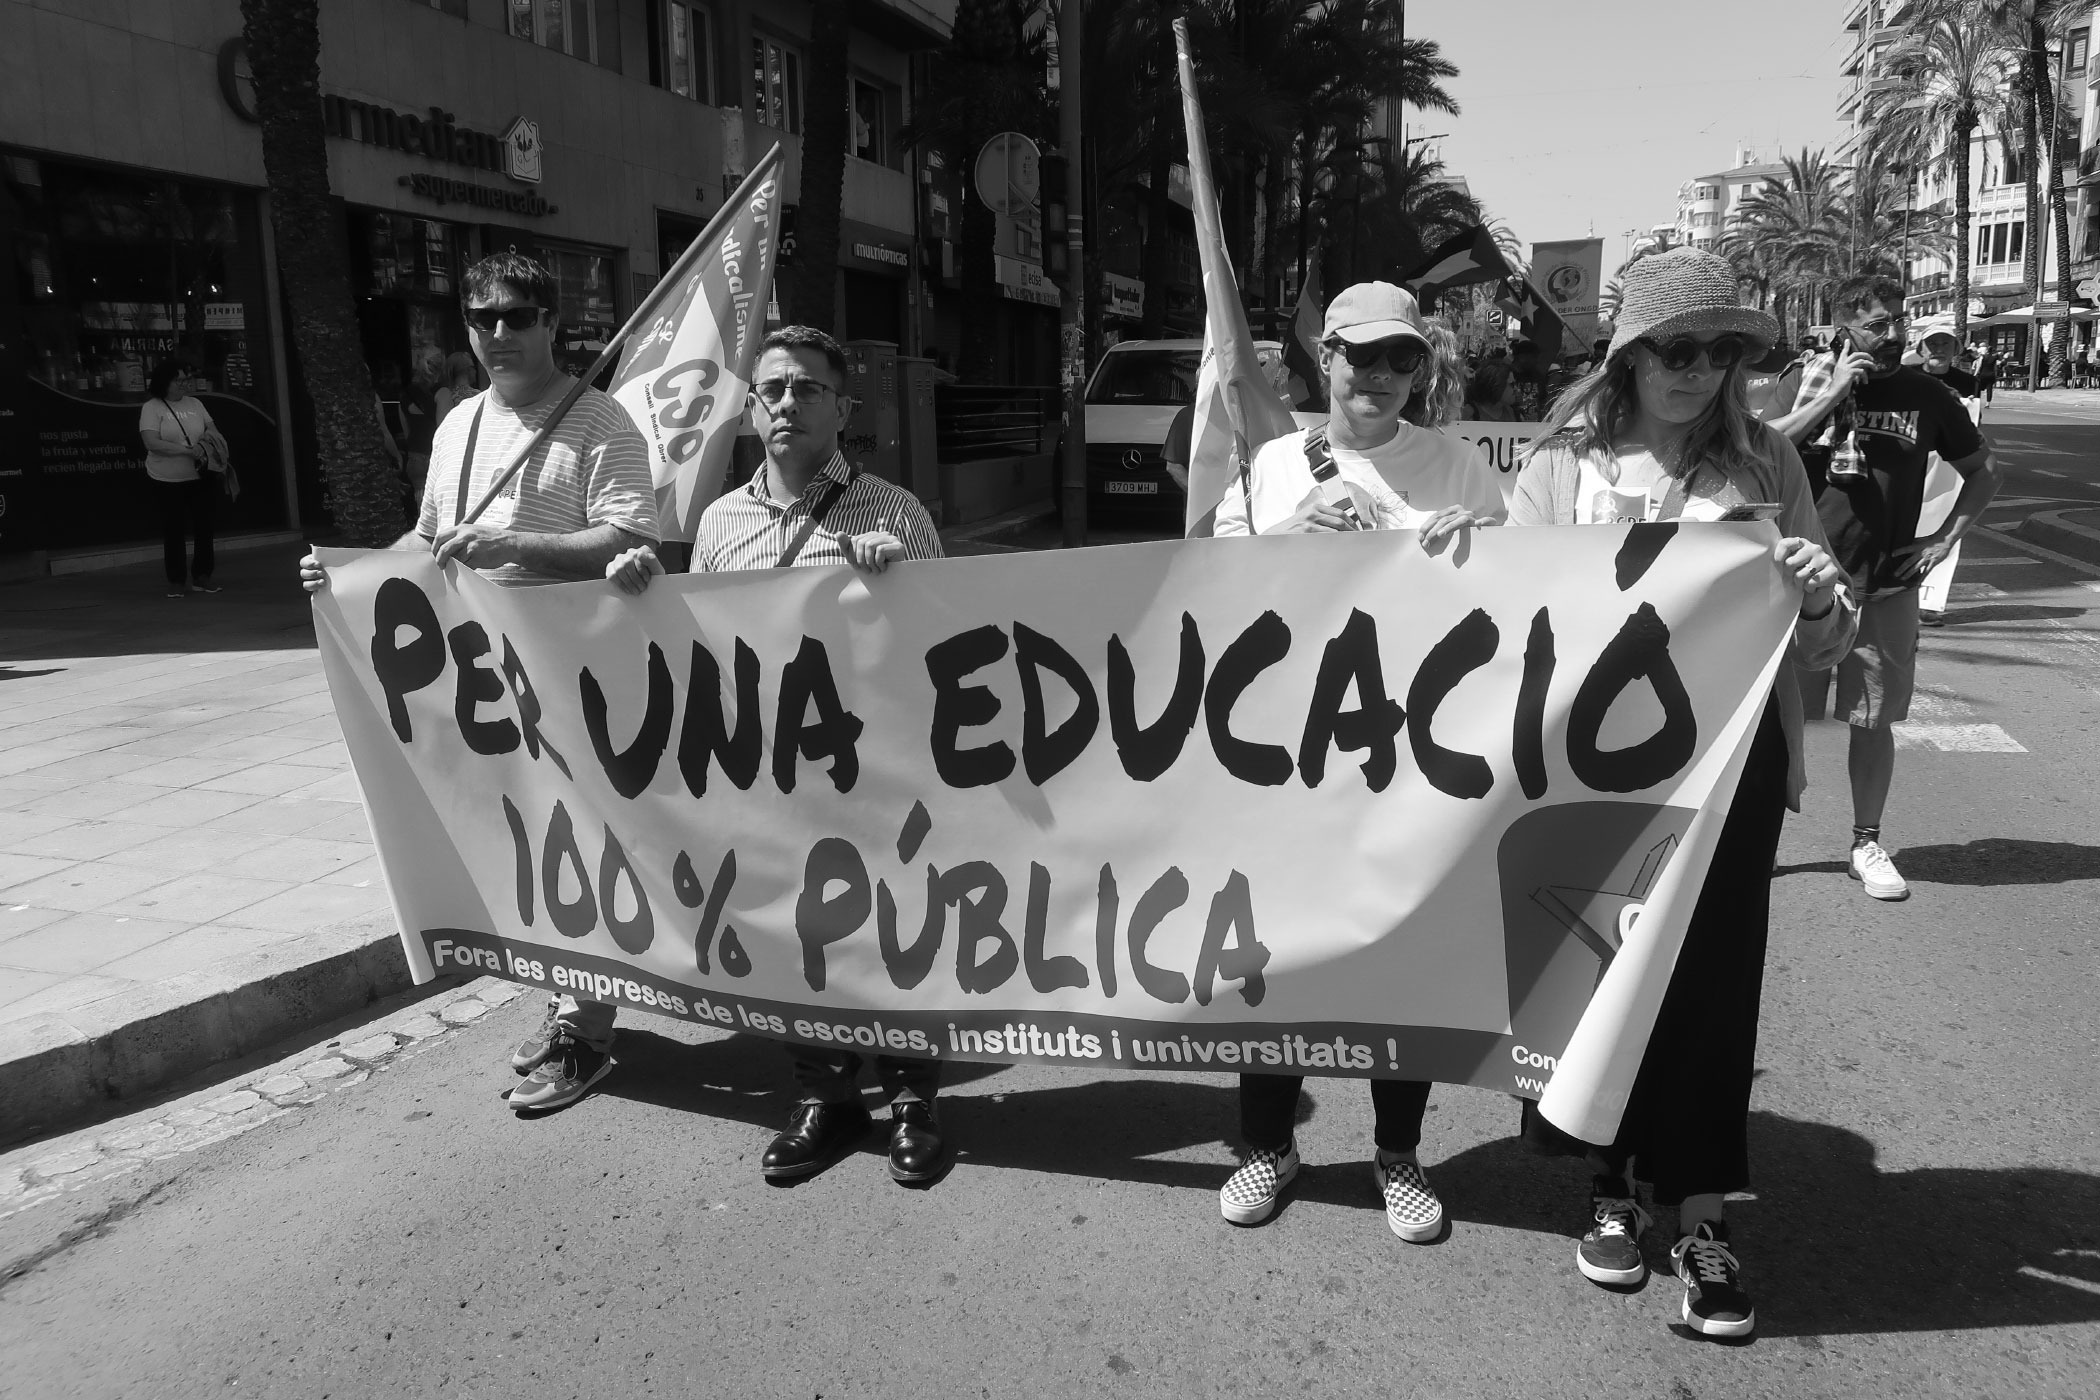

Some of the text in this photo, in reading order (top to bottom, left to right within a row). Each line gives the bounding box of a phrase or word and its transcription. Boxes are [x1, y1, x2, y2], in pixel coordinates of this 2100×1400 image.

[749, 178, 776, 272] Per un
[652, 358, 720, 466] CSO
[1856, 410, 1920, 440] STINA
[53, 446, 78, 456] fruta
[89, 445, 126, 455] verdura
[77, 461, 112, 473] llegada
[114, 460, 126, 469] de
[1111, 482, 1135, 493] 3709
[371, 522, 1698, 800] PER UNA EDUCACIÓ
[795, 799, 1271, 1007] PÚBLICA
[434, 940, 502, 971] Fora
[506, 947, 545, 981] les
[552, 965, 686, 1016] empreses
[693, 996, 732, 1023] de
[740, 1002, 787, 1035] les
[795, 1013, 939, 1055] escoles,
[948, 1023, 1101, 1060] instituts
[1111, 1028, 1121, 1061] i
[1132, 1033, 1375, 1071] universitats
[1511, 1045, 1561, 1072] Con
